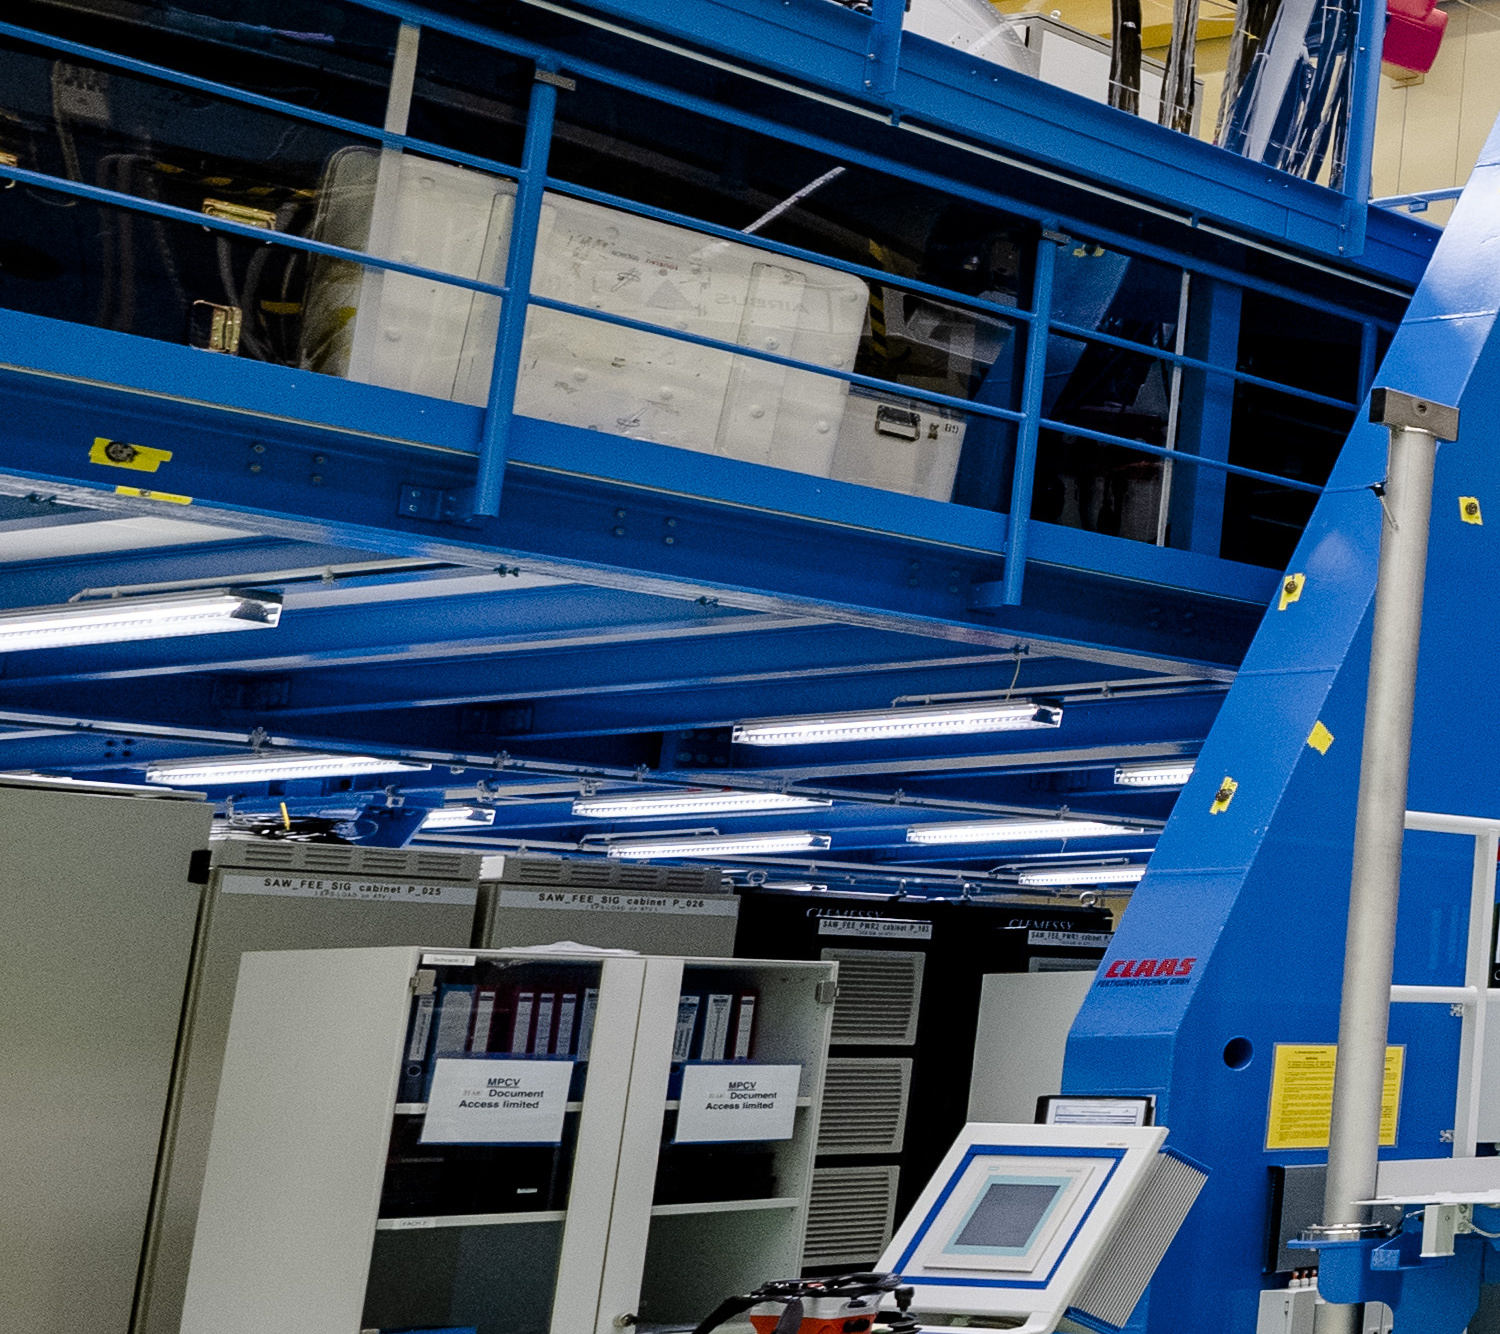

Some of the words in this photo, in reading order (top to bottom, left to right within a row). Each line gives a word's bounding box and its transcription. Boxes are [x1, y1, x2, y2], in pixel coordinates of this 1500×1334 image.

[359, 884, 402, 894] cabinet
[627, 897, 667, 906] cabinet
[1105, 957, 1197, 978] CLAAS
[486, 1077, 521, 1088] MPCV
[728, 1081, 757, 1090] MPCV
[489, 1089, 544, 1098] Document
[729, 1091, 777, 1100] Document
[459, 1100, 499, 1109] Access
[502, 1099, 540, 1109] limited
[705, 1101, 740, 1110] Access
[742, 1101, 774, 1110] limited
